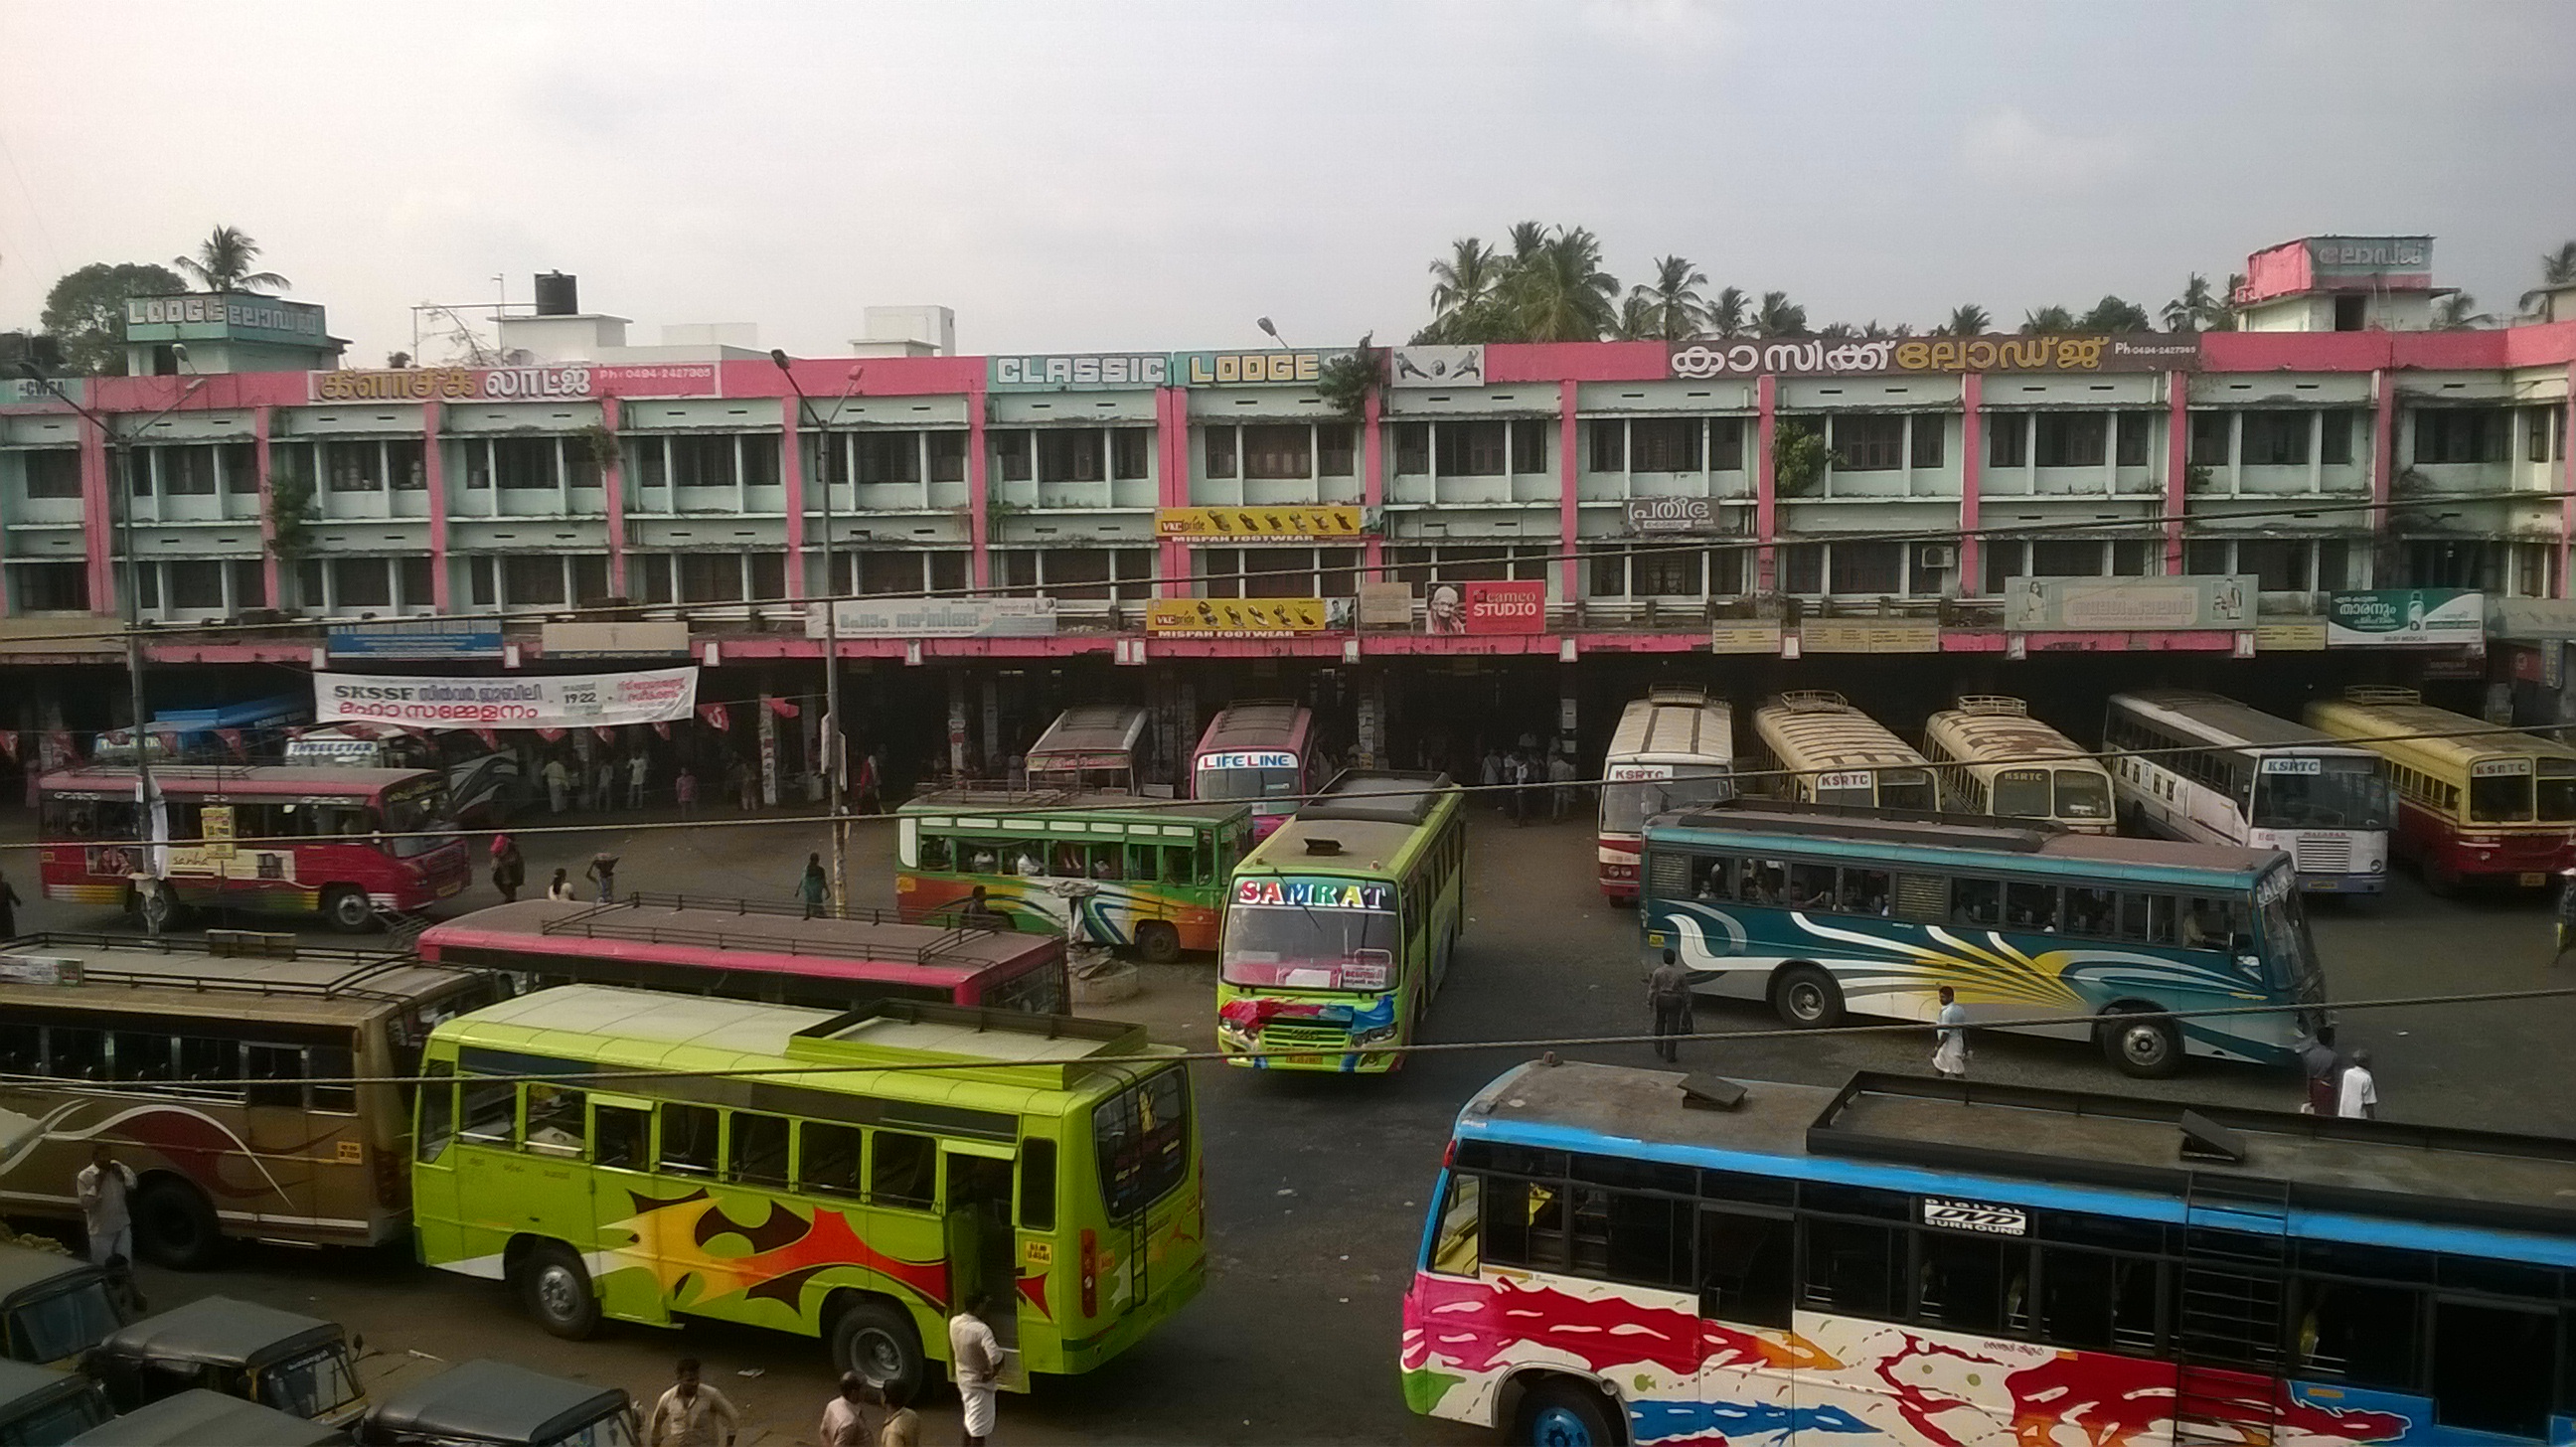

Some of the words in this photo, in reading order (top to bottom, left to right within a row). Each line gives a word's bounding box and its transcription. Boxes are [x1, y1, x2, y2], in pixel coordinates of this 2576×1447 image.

[127, 299, 225, 324] LODGE
[1895, 336, 2110, 371] ലോഡ്ജ്
[997, 357, 1166, 383] CLASSIC
[1192, 354, 1319, 383] LODGE
[1473, 602, 1537, 617] STUDIO
[2339, 603, 2397, 617] താരനും
[334, 685, 414, 702] SKSSF
[2267, 761, 2318, 771] KSRTC
[2476, 764, 2527, 774] KSRTC
[1616, 769, 1665, 782] KSRTC
[1822, 773, 1869, 786] KSRTC
[2004, 772, 2043, 781] KSRTC
[1239, 881, 1386, 909] SAMRAT
[1925, 1199, 2026, 1215] DIGITAL
[1929, 1208, 2022, 1225] DVD
[1925, 1218, 2024, 1236] SURROUND
